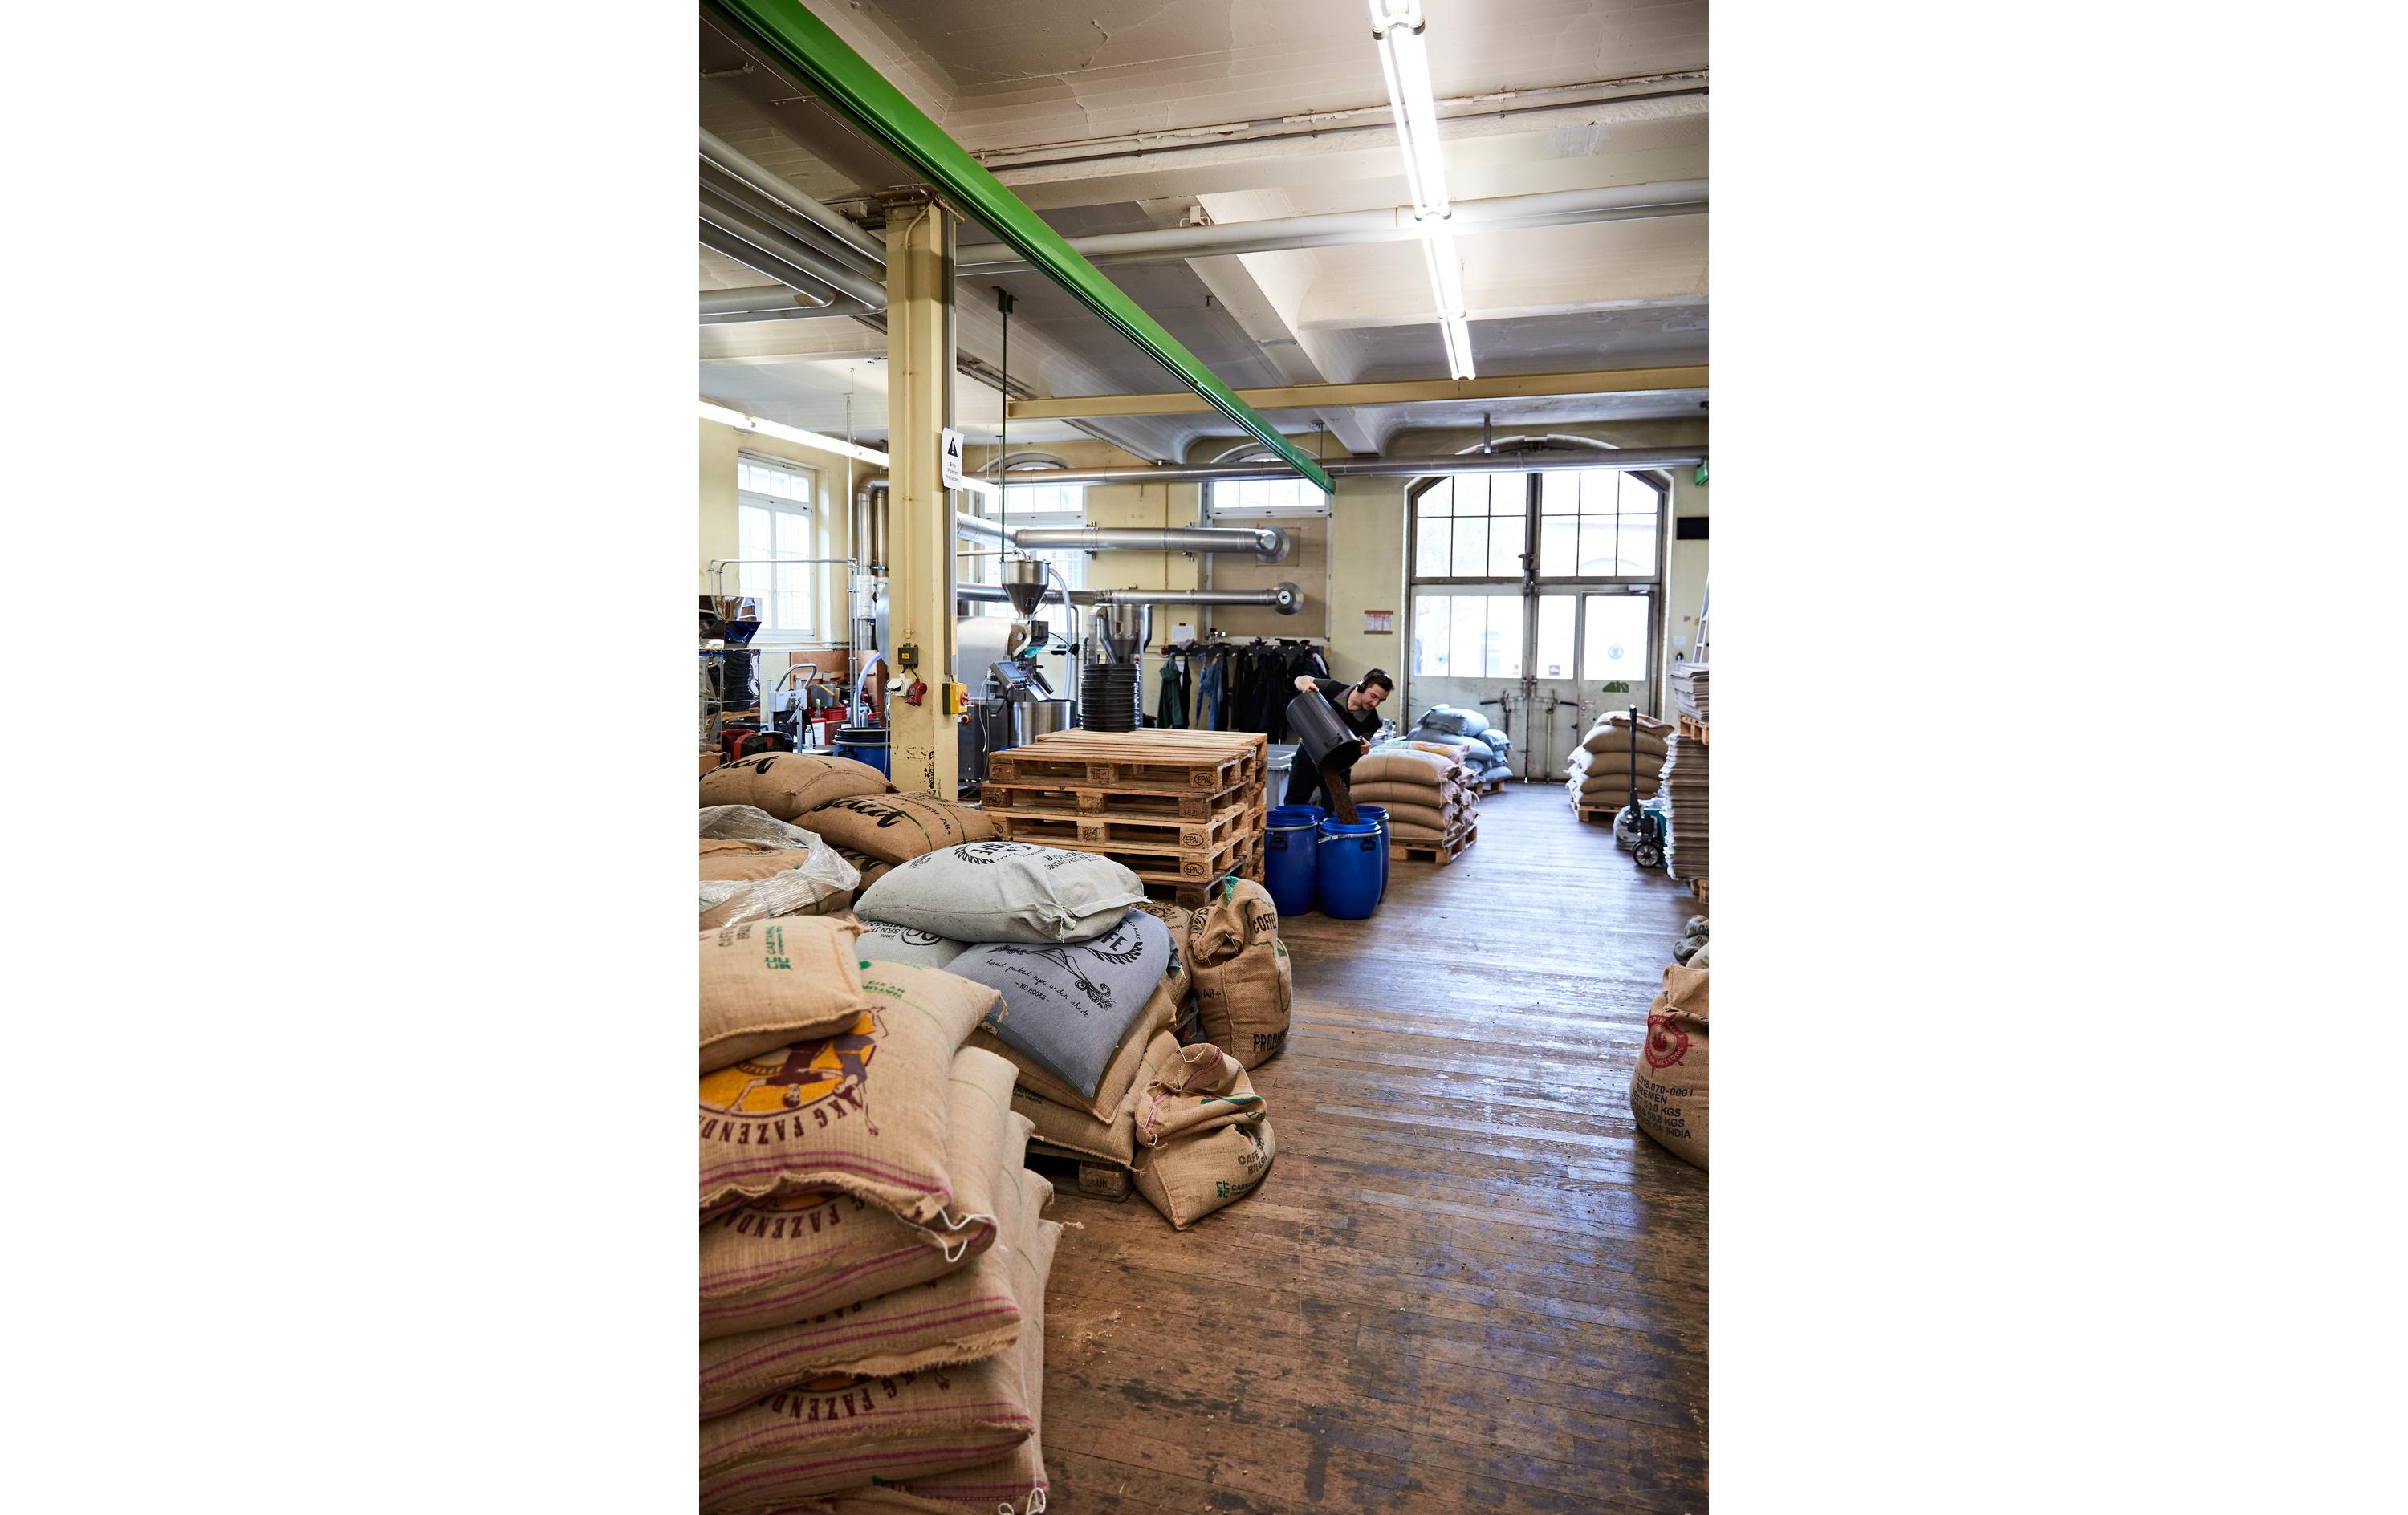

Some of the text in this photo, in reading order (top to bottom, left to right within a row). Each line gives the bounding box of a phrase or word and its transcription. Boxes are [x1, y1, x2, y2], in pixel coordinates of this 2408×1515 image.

[1197, 774, 1212, 785] EPAL
[1186, 835, 1201, 844] EPAL
[1186, 865, 1201, 875] EPAL
[881, 927, 901, 935] SAN
[986, 958, 1007, 968] hand
[1005, 965, 1034, 977] picked
[1049, 984, 1068, 1000] under
[1070, 1000, 1089, 1018] shade
[1019, 981, 1047, 1001] NO HOOKS
[1636, 1082, 1668, 1105] BREMEN
[1661, 1106, 1682, 1118] KGS
[1664, 1116, 1686, 1128] KGS
[699, 1115, 805, 1145] FAZEND
[1666, 1127, 1692, 1139] INDIA
[1257, 1137, 1265, 1151] DO
[723, 1204, 841, 1240] FAZENDA
[771, 1388, 876, 1420] FAZEND
